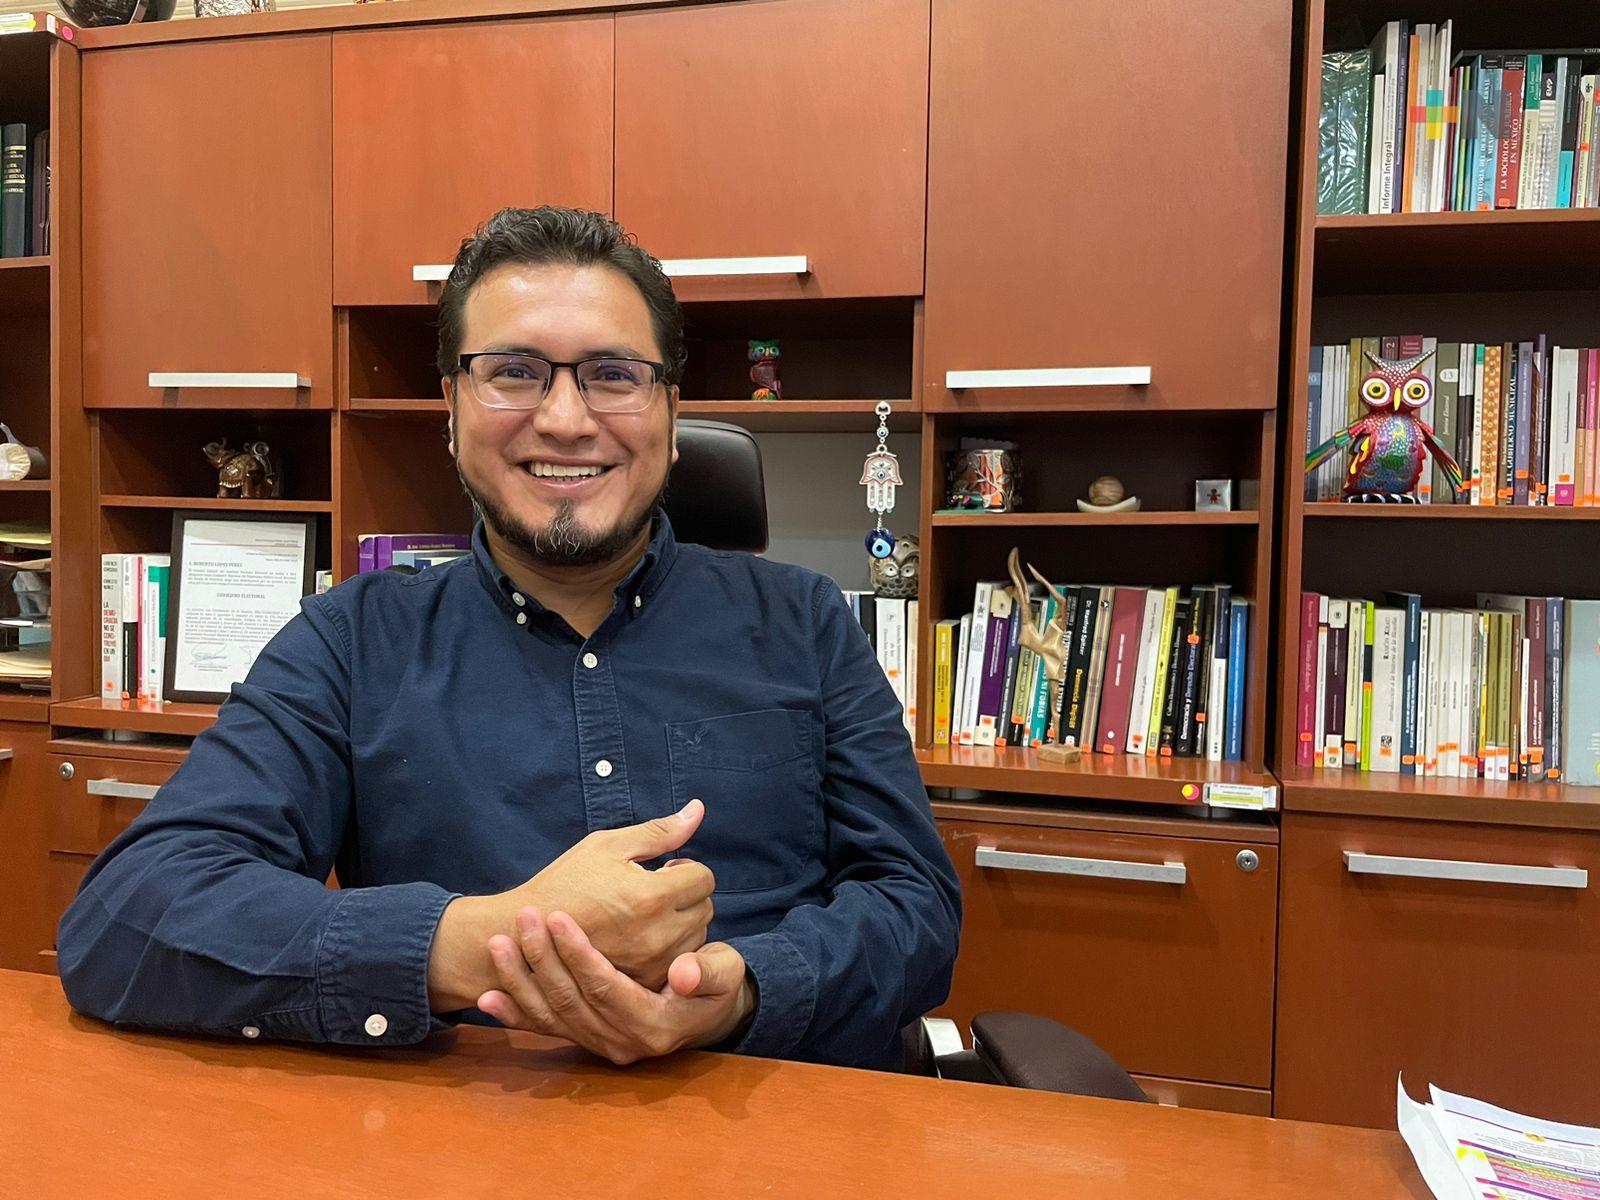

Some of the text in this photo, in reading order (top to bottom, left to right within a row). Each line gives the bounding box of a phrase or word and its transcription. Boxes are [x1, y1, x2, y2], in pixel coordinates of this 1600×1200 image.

[1511, 152, 1516, 163] EN
[1382, 142, 1392, 209] Informe Integral
[1502, 179, 1507, 189] LA
[1507, 470, 1513, 482] EL
[1082, 610, 1090, 633] Manfred
[1187, 644, 1196, 670] Electora
[1072, 668, 1083, 702] Demencia
[1185, 671, 1194, 697] Derecho
[1036, 691, 1046, 718] FOBIAS
[1180, 704, 1190, 740] Democracia
